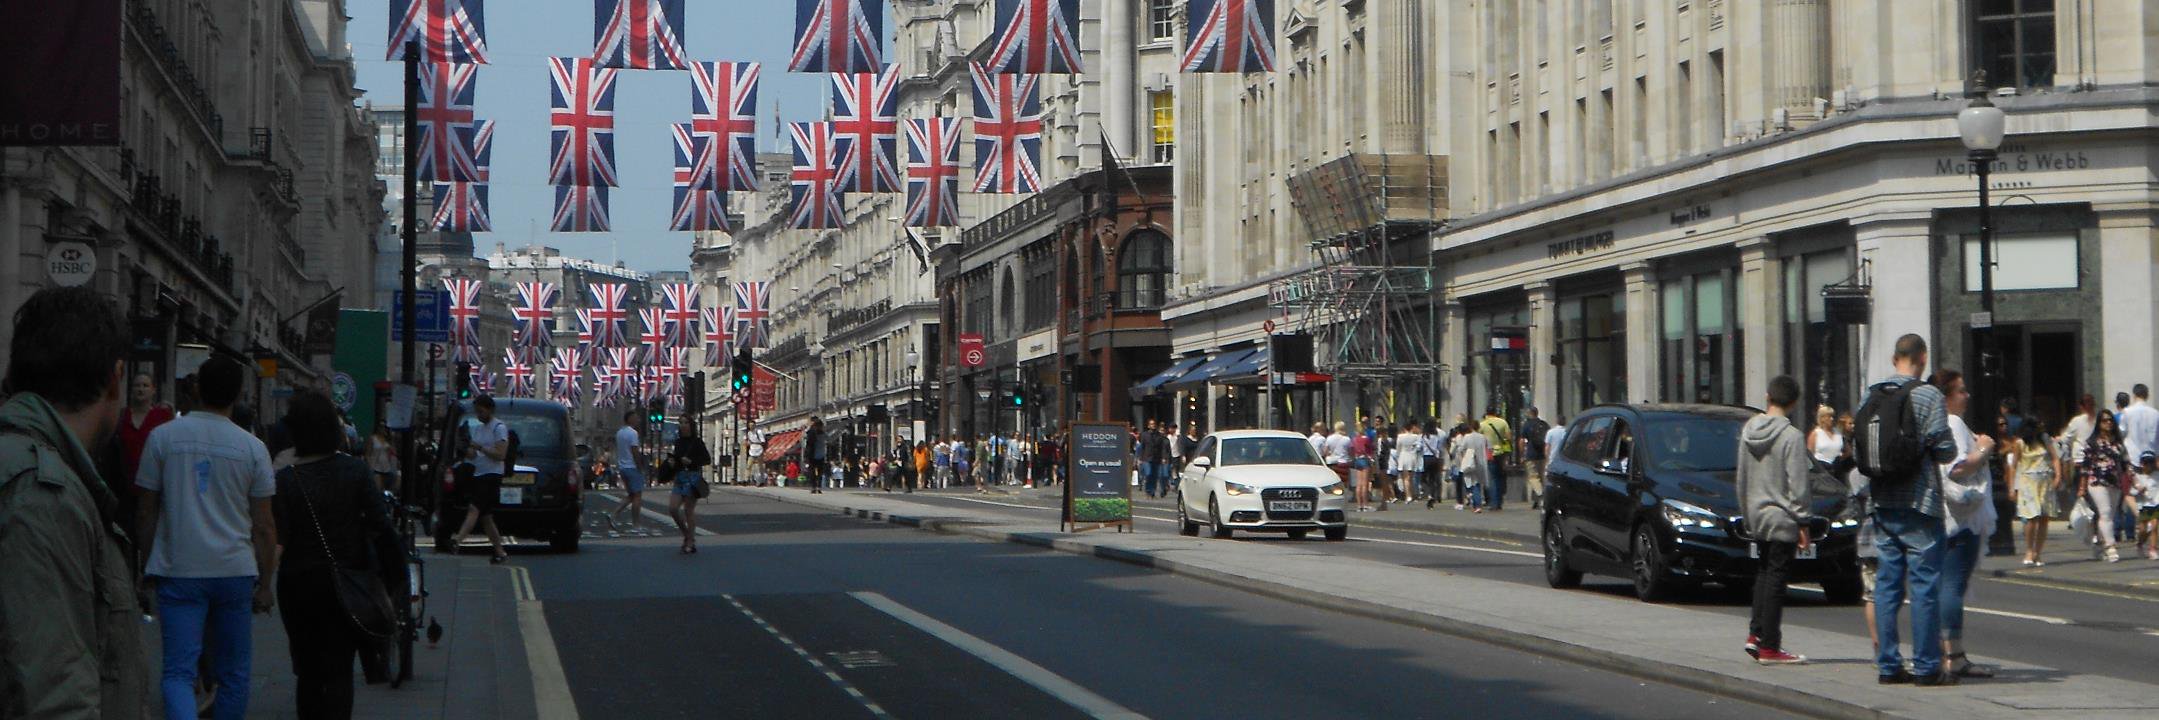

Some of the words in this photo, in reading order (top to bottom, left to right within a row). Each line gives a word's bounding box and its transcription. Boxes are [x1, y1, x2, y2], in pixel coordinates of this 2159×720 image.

[2, 123, 113, 140] HOME
[1935, 158, 2007, 179] Mapin
[2016, 155, 2028, 171] &
[2036, 152, 2088, 170] Webb
[51, 262, 90, 274] HSBC
